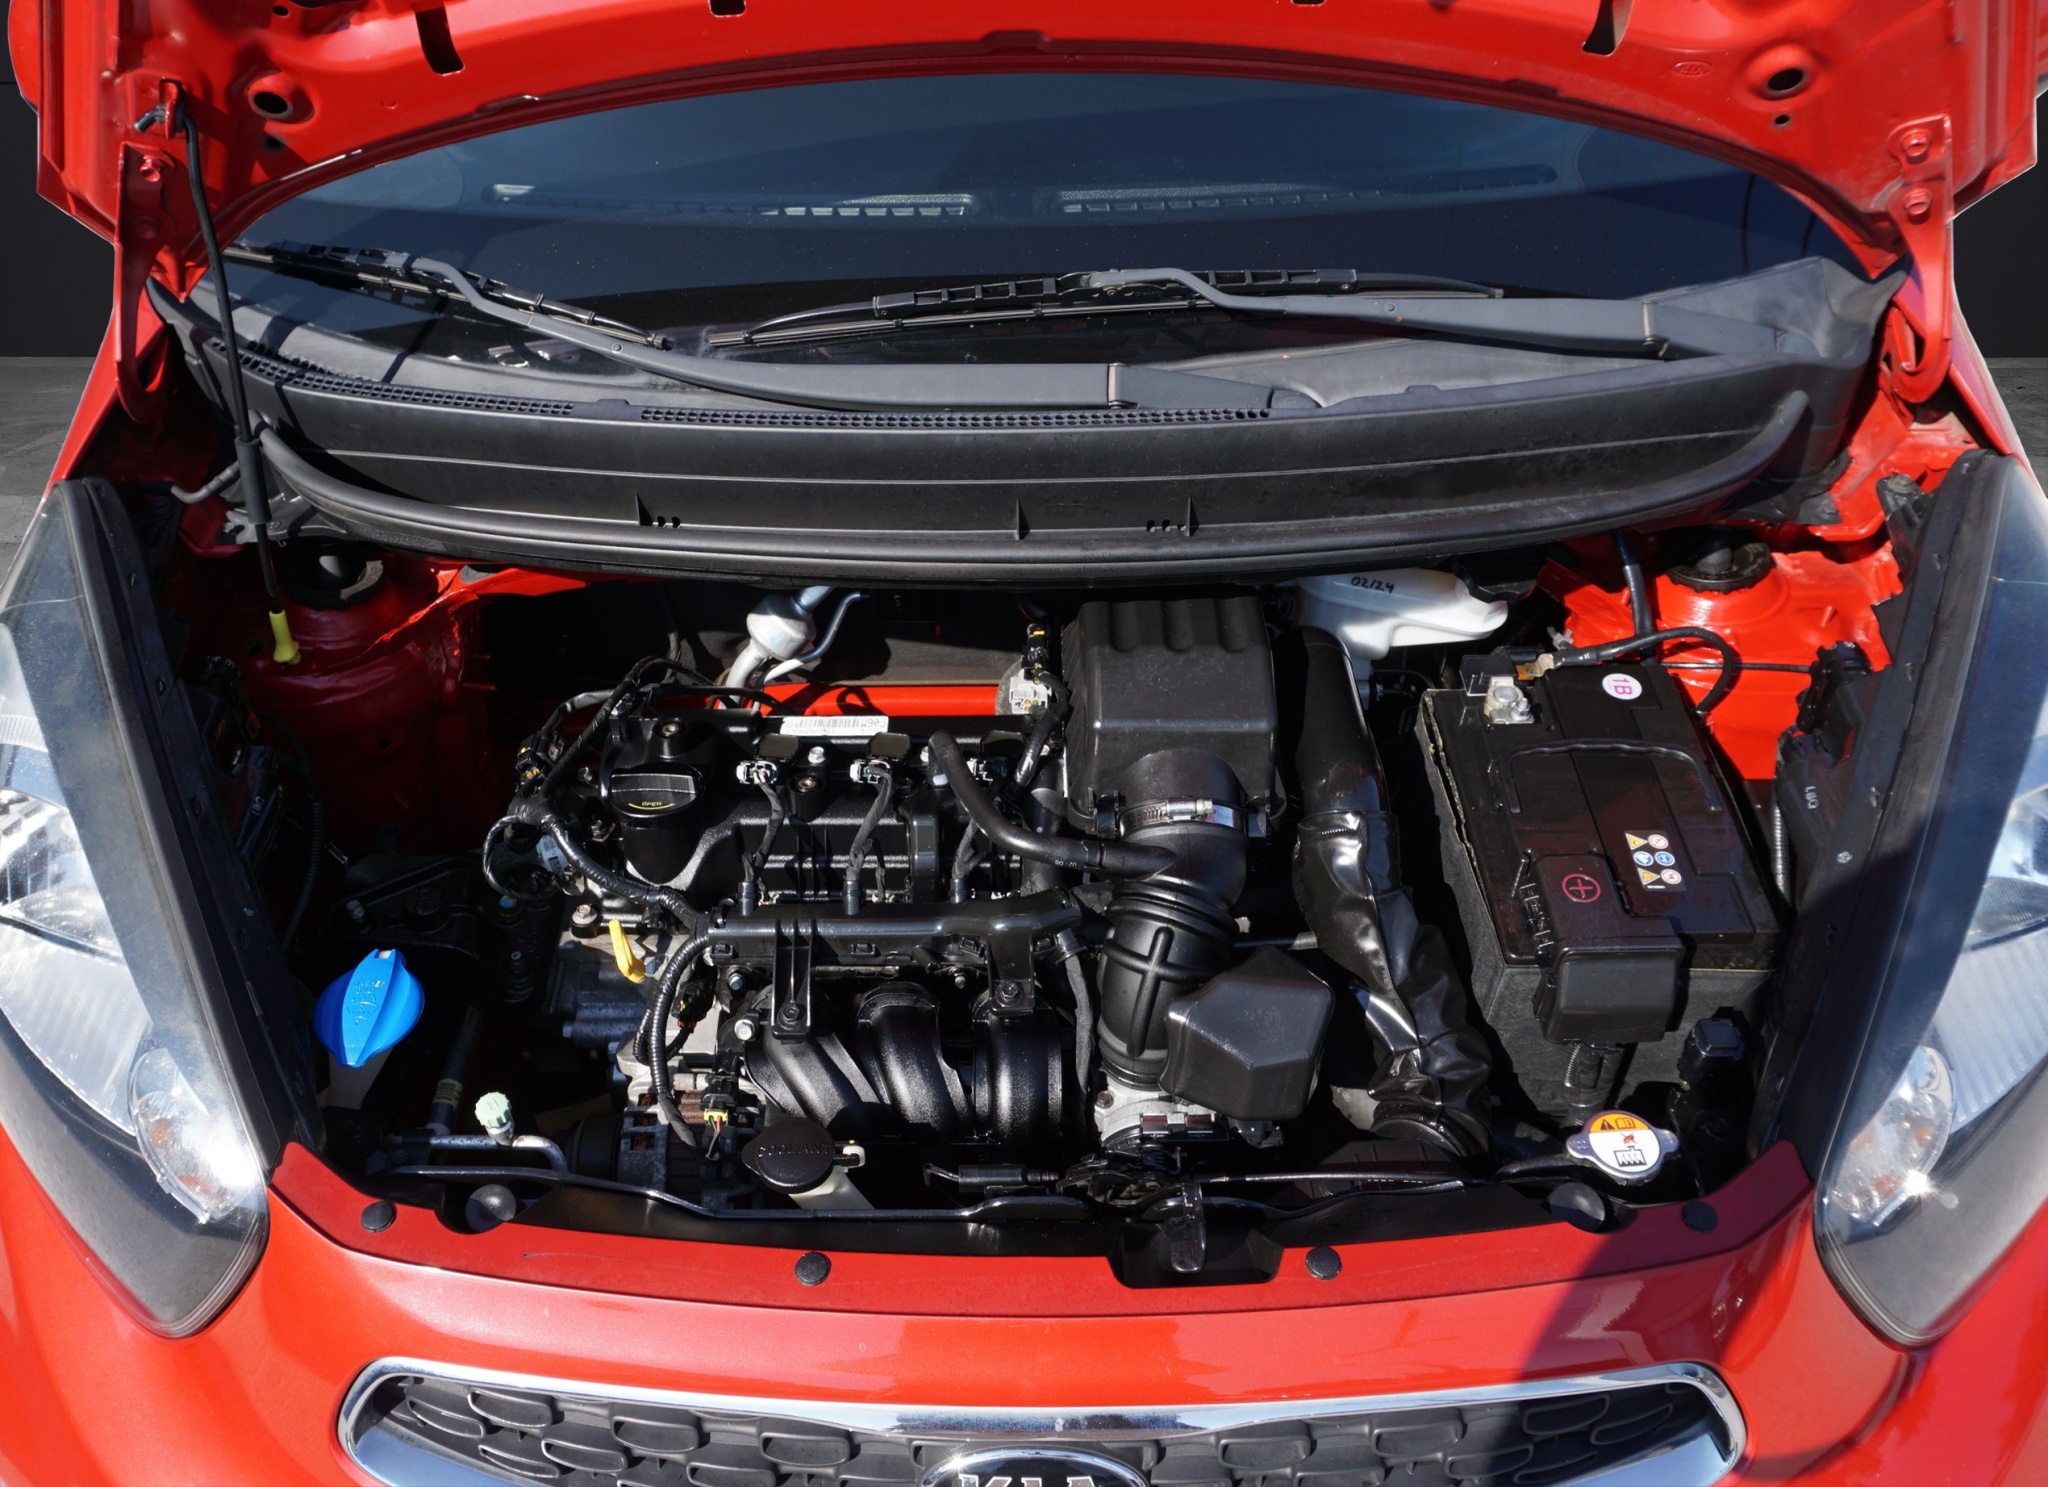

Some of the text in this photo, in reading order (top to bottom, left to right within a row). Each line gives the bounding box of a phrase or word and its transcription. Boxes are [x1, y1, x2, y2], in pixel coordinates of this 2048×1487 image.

[1350, 576, 1395, 593] 02/24
[1612, 677, 1633, 695] 1B
[758, 1143, 832, 1158] COOLANT
